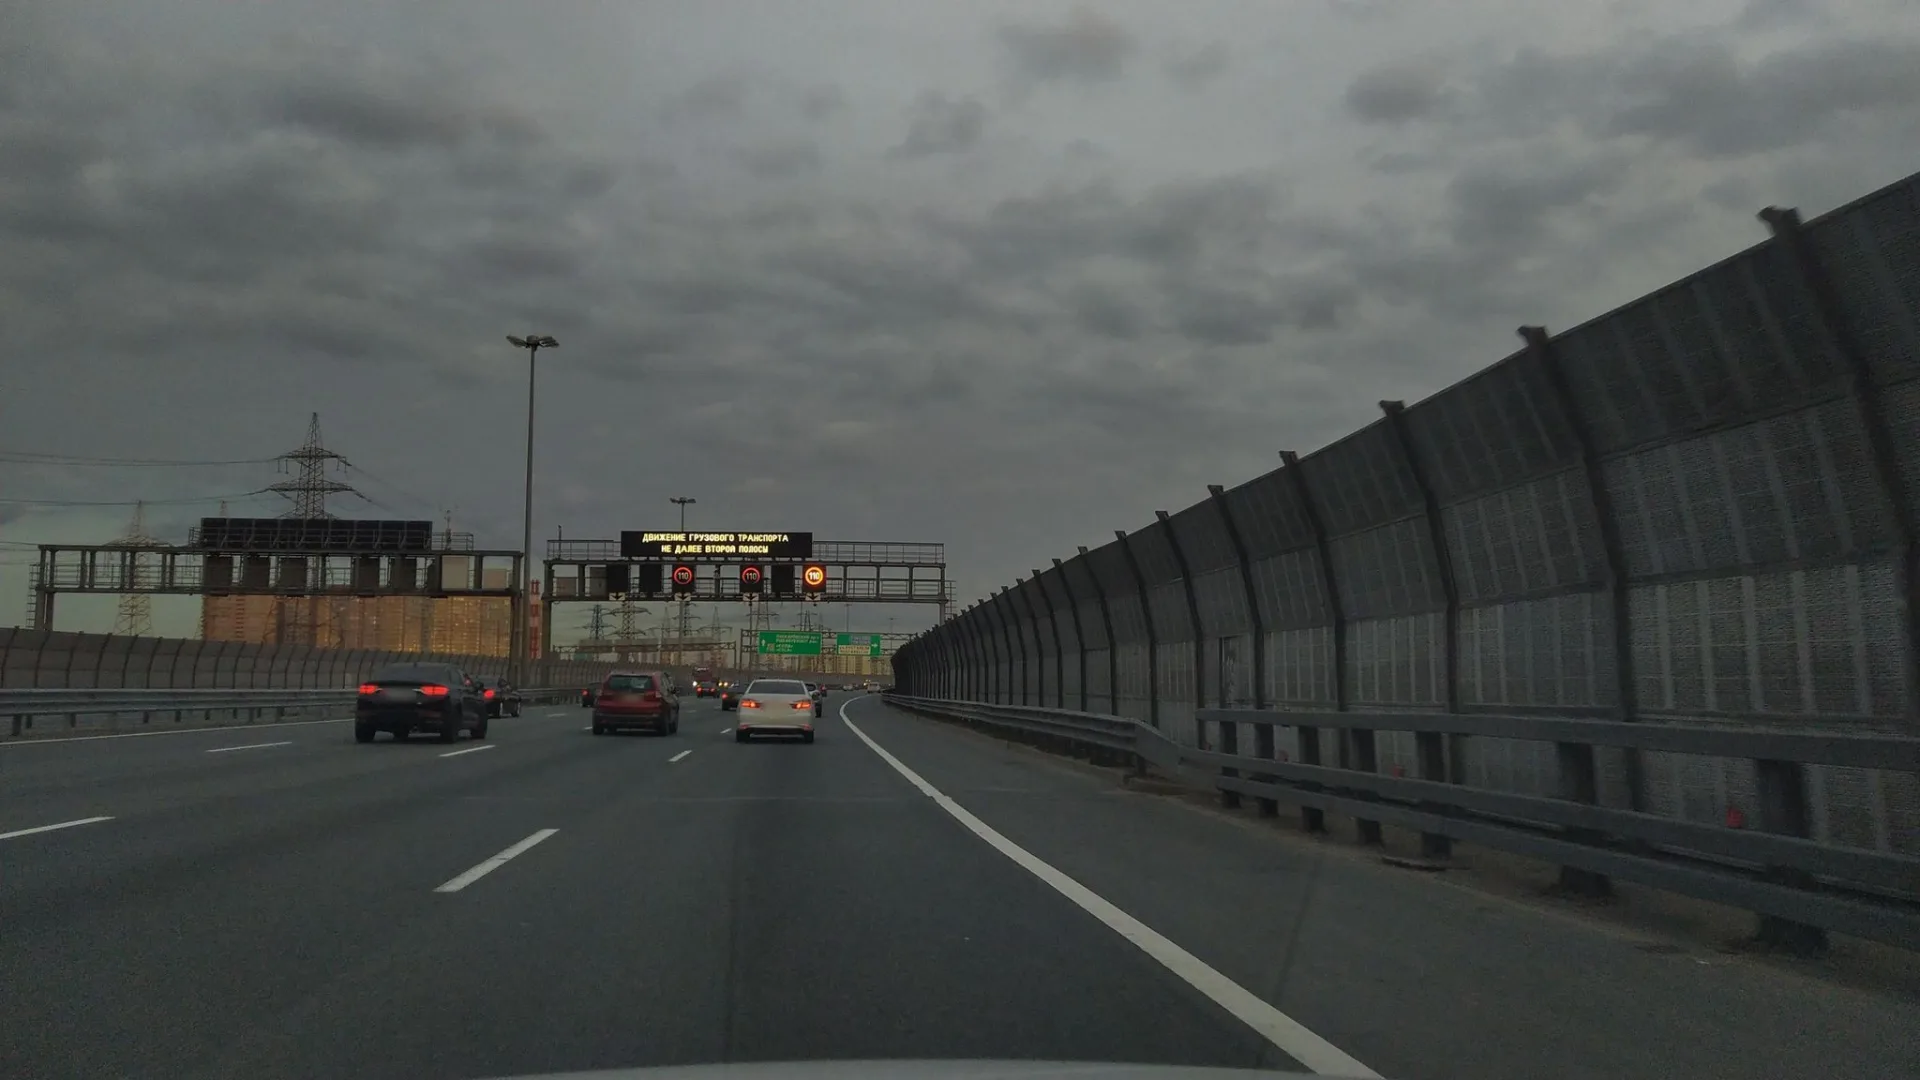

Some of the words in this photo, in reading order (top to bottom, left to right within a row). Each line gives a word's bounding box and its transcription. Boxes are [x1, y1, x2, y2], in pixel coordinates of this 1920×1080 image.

[642, 533, 686, 543] ДВИЖЕНИЕ
[689, 533, 734, 542] ГРУЗОВОГО
[738, 534, 789, 542] ТРАНСПОРТА
[661, 545, 672, 553] НЕ
[674, 545, 702, 554] ДАЛЕЕ
[705, 545, 736, 553] ВТОРОЙ
[739, 545, 769, 553] ПОЛОСЫ
[677, 572, 689, 580] 110
[745, 572, 757, 580] 110
[809, 572, 820, 580] 110
